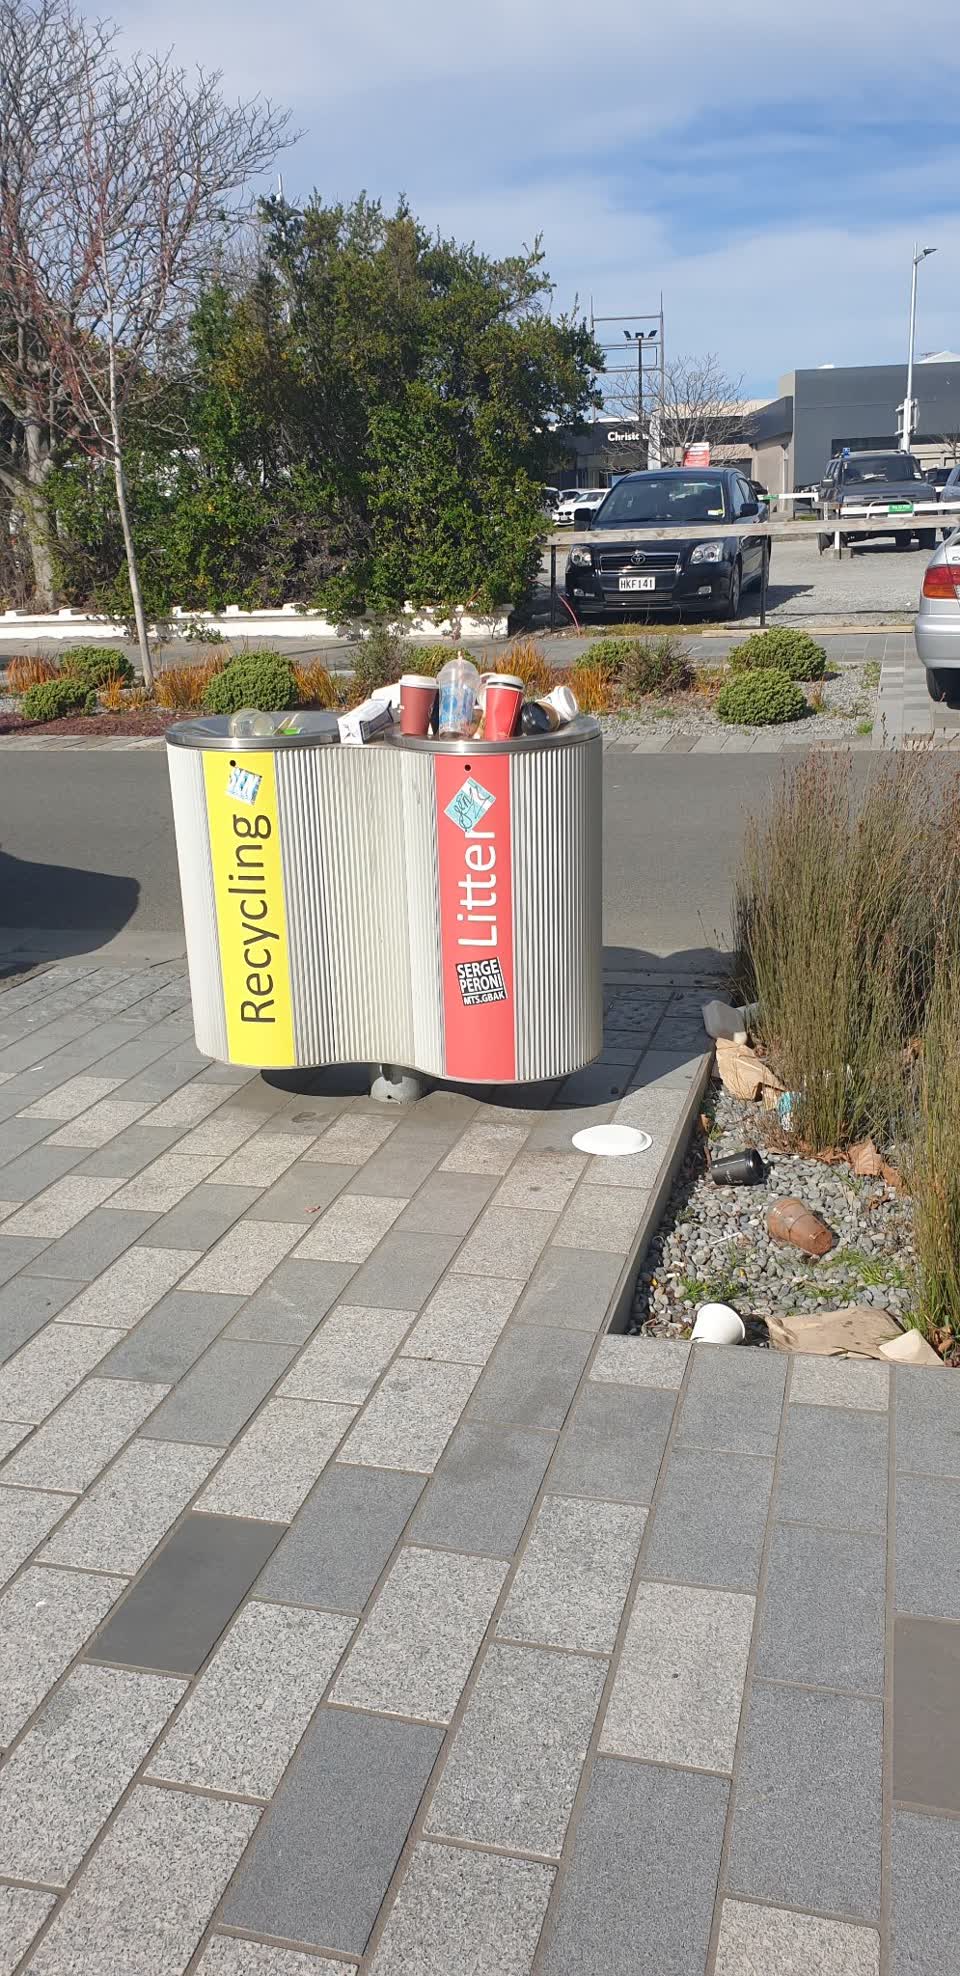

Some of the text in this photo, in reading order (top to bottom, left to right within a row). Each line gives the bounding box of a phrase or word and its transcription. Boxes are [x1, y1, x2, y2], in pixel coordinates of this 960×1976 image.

[620, 579, 653, 589] HKF141
[456, 830, 498, 946] Litter
[228, 814, 280, 1023] Recycling
[456, 959, 500, 979] SERGE
[459, 973, 503, 994] PERONI
[463, 990, 505, 1005] MTS.GBAK
